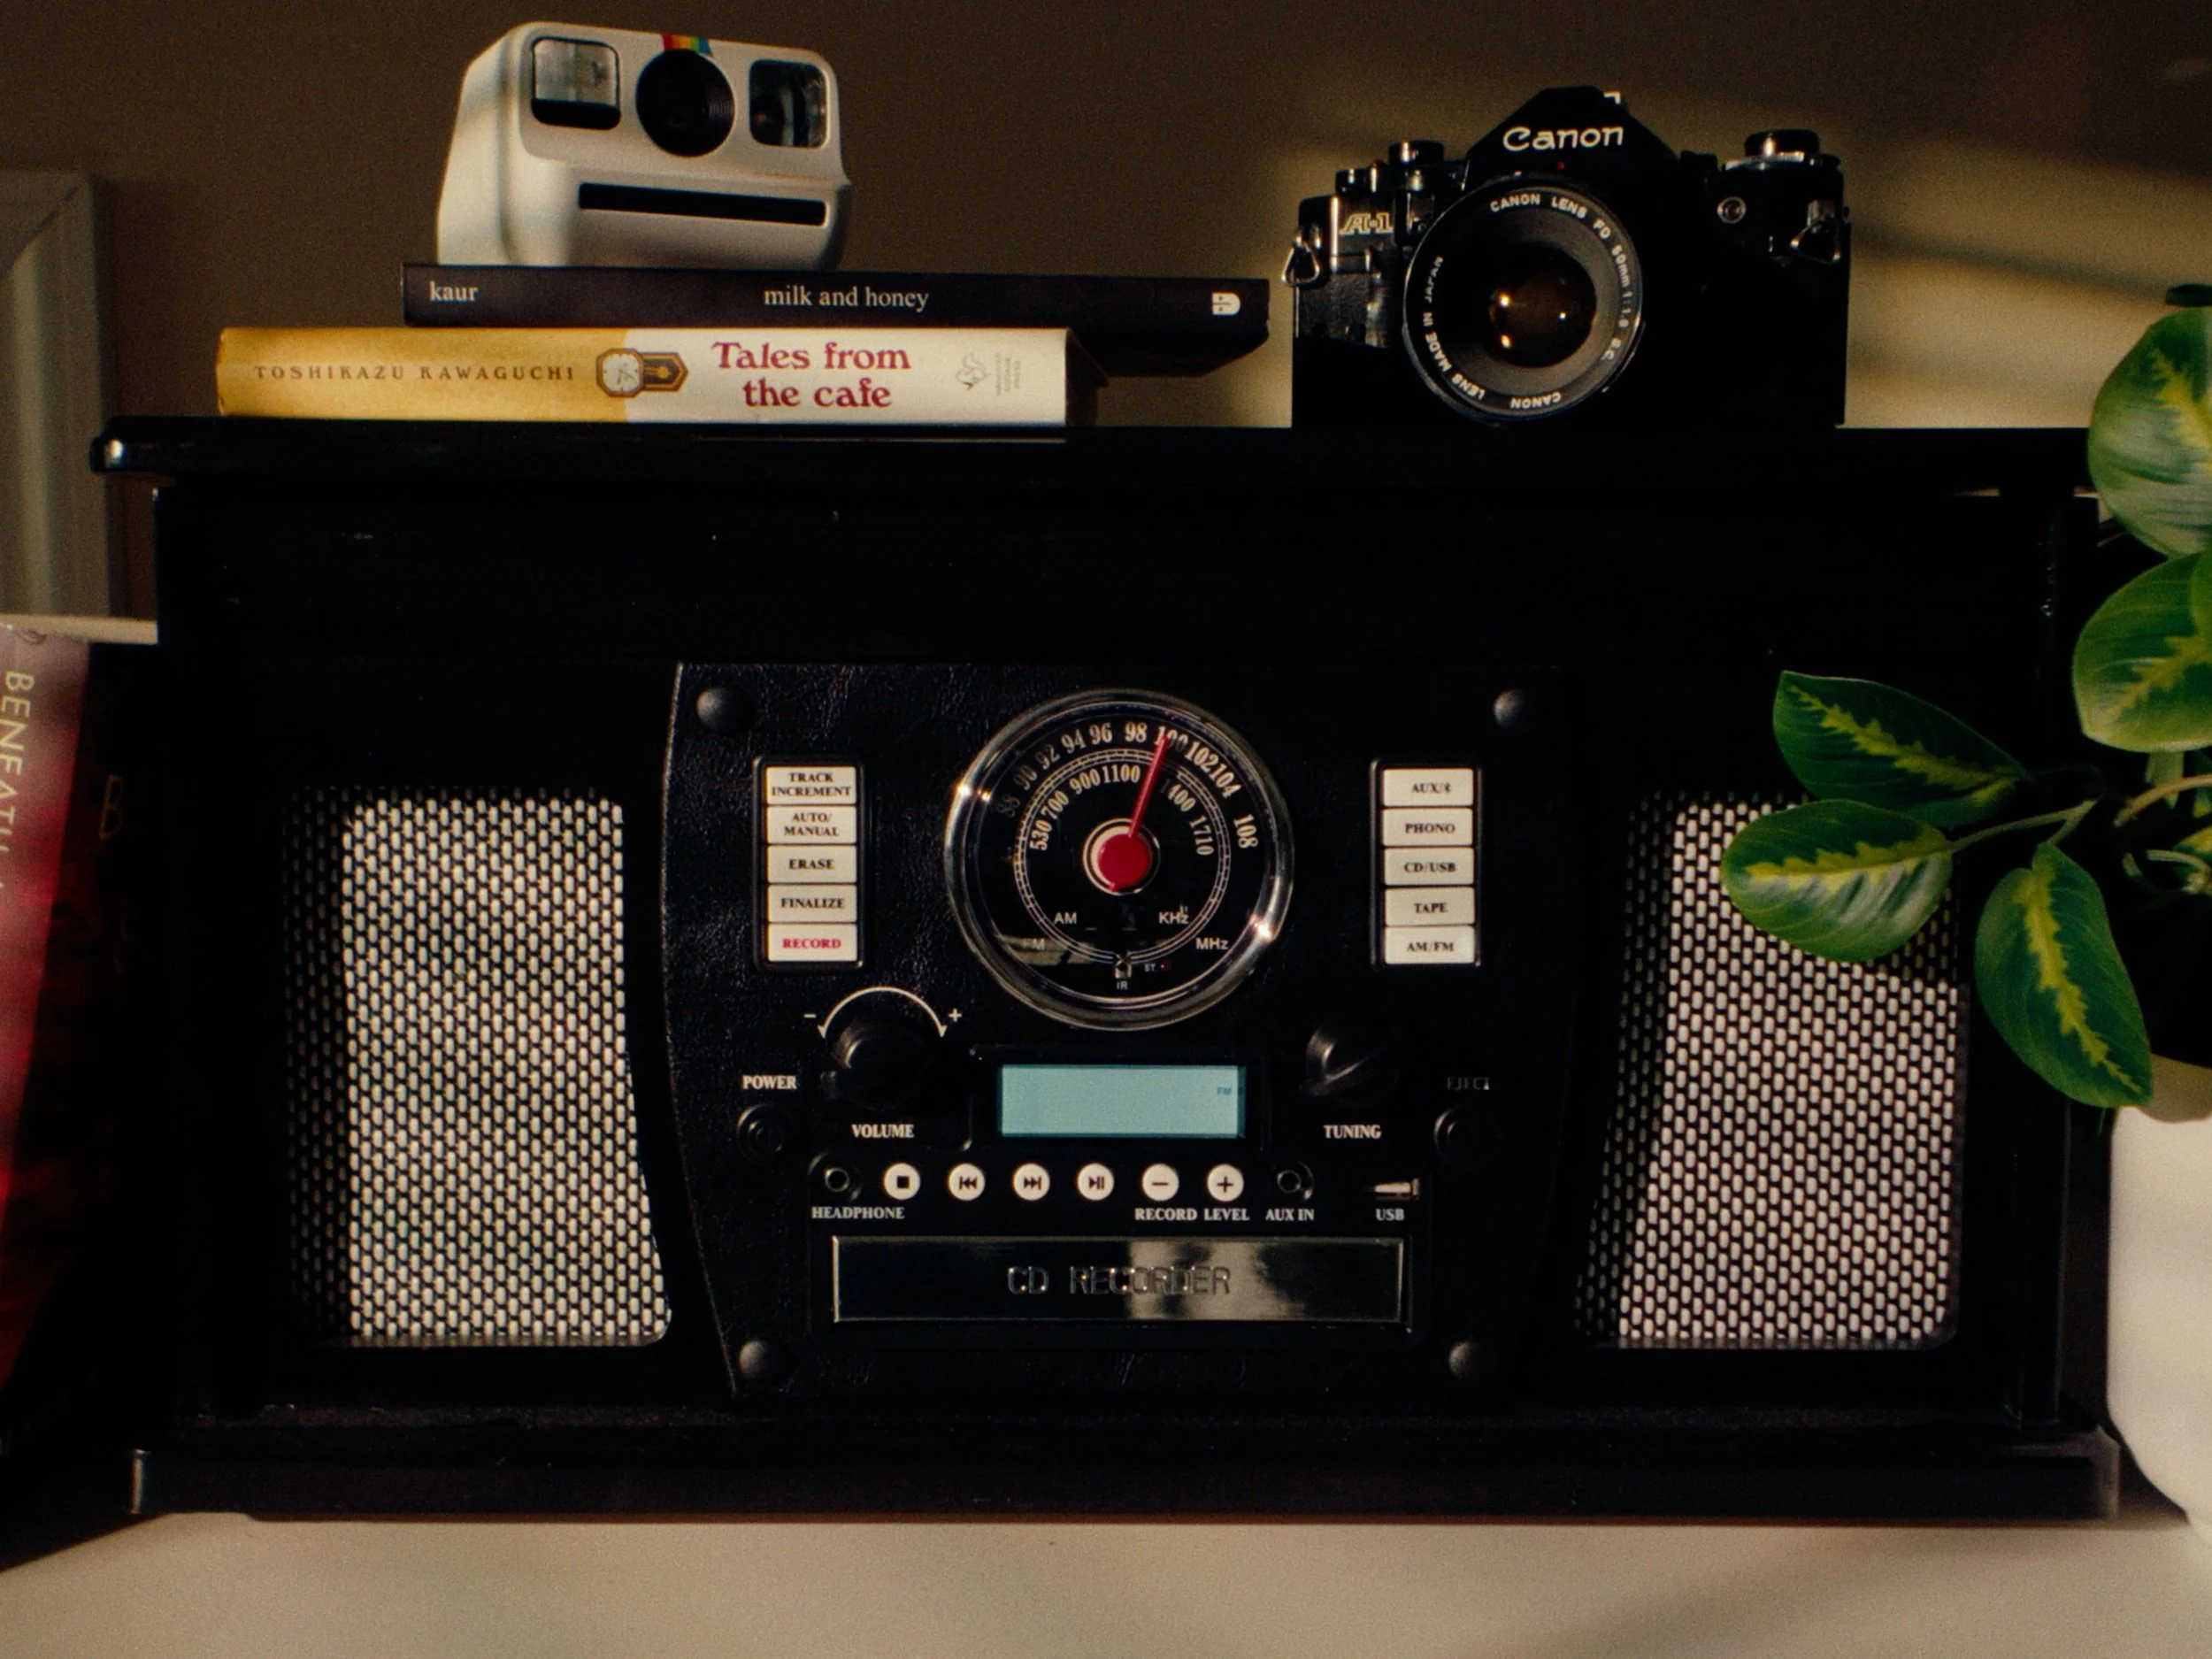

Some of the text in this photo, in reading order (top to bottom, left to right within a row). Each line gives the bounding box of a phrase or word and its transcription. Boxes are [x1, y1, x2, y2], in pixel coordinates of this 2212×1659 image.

[1503, 126, 1624, 151] Canon
[1339, 211, 1394, 235] A-1
[1490, 193, 1541, 212] CANON
[1551, 196, 1588, 219] LENS
[1593, 219, 1611, 240] FD
[1611, 244, 1631, 288] 50mm
[429, 281, 479, 303] kaur
[763, 286, 929, 311] milk and honey
[1422, 256, 1562, 410] CANON LENS MADE IN JAPAN
[710, 341, 912, 371] Tales from
[255, 365, 576, 382] TOSHIKAZU KAWAGUCHI
[743, 377, 893, 408] the cafe
[789, 772, 833, 783] TRACK
[1102, 763, 1141, 785] 1100
[1035, 744, 1060, 770] 92
[1061, 729, 1087, 754] 94
[1089, 722, 1113, 745] 96
[1125, 722, 1148, 743] 98
[1184, 741, 1219, 773] 102
[1208, 764, 1242, 799] 104
[1233, 813, 1259, 849] 108
[1069, 768, 1102, 795] 900
[772, 787, 851, 796] INCREMENT
[1040, 789, 1070, 820] 700
[792, 813, 832, 823] AUTO/
[784, 827, 839, 837] MANUAL
[1029, 819, 1053, 851] 530
[1189, 815, 1215, 856] 1710
[1405, 824, 1455, 833] PHONO
[788, 859, 834, 870] ERASE
[1403, 863, 1456, 873] CD/USB
[780, 898, 845, 910] FINALIZE
[1414, 903, 1448, 914] TAPE
[1054, 912, 1077, 925] AM
[1159, 912, 1189, 925] KHz
[782, 938, 841, 949] RECORD
[1196, 938, 1229, 950] MHz
[1407, 941, 1455, 952] AM/FM
[1117, 980, 1129, 991] IR
[741, 1075, 797, 1090] POWER
[1447, 1076, 1490, 1091] EJECT
[1217, 1087, 1232, 1095] FM
[851, 1124, 915, 1139] VOLUME
[1324, 1125, 1381, 1140] TUNING
[811, 1206, 905, 1220] HEADPHONE
[1135, 1208, 1249, 1221] RECORD LEVEL
[1265, 1208, 1315, 1221] AUX IN
[1376, 1209, 1405, 1222] USB
[1008, 1266, 1232, 1295] CD RECORDER
